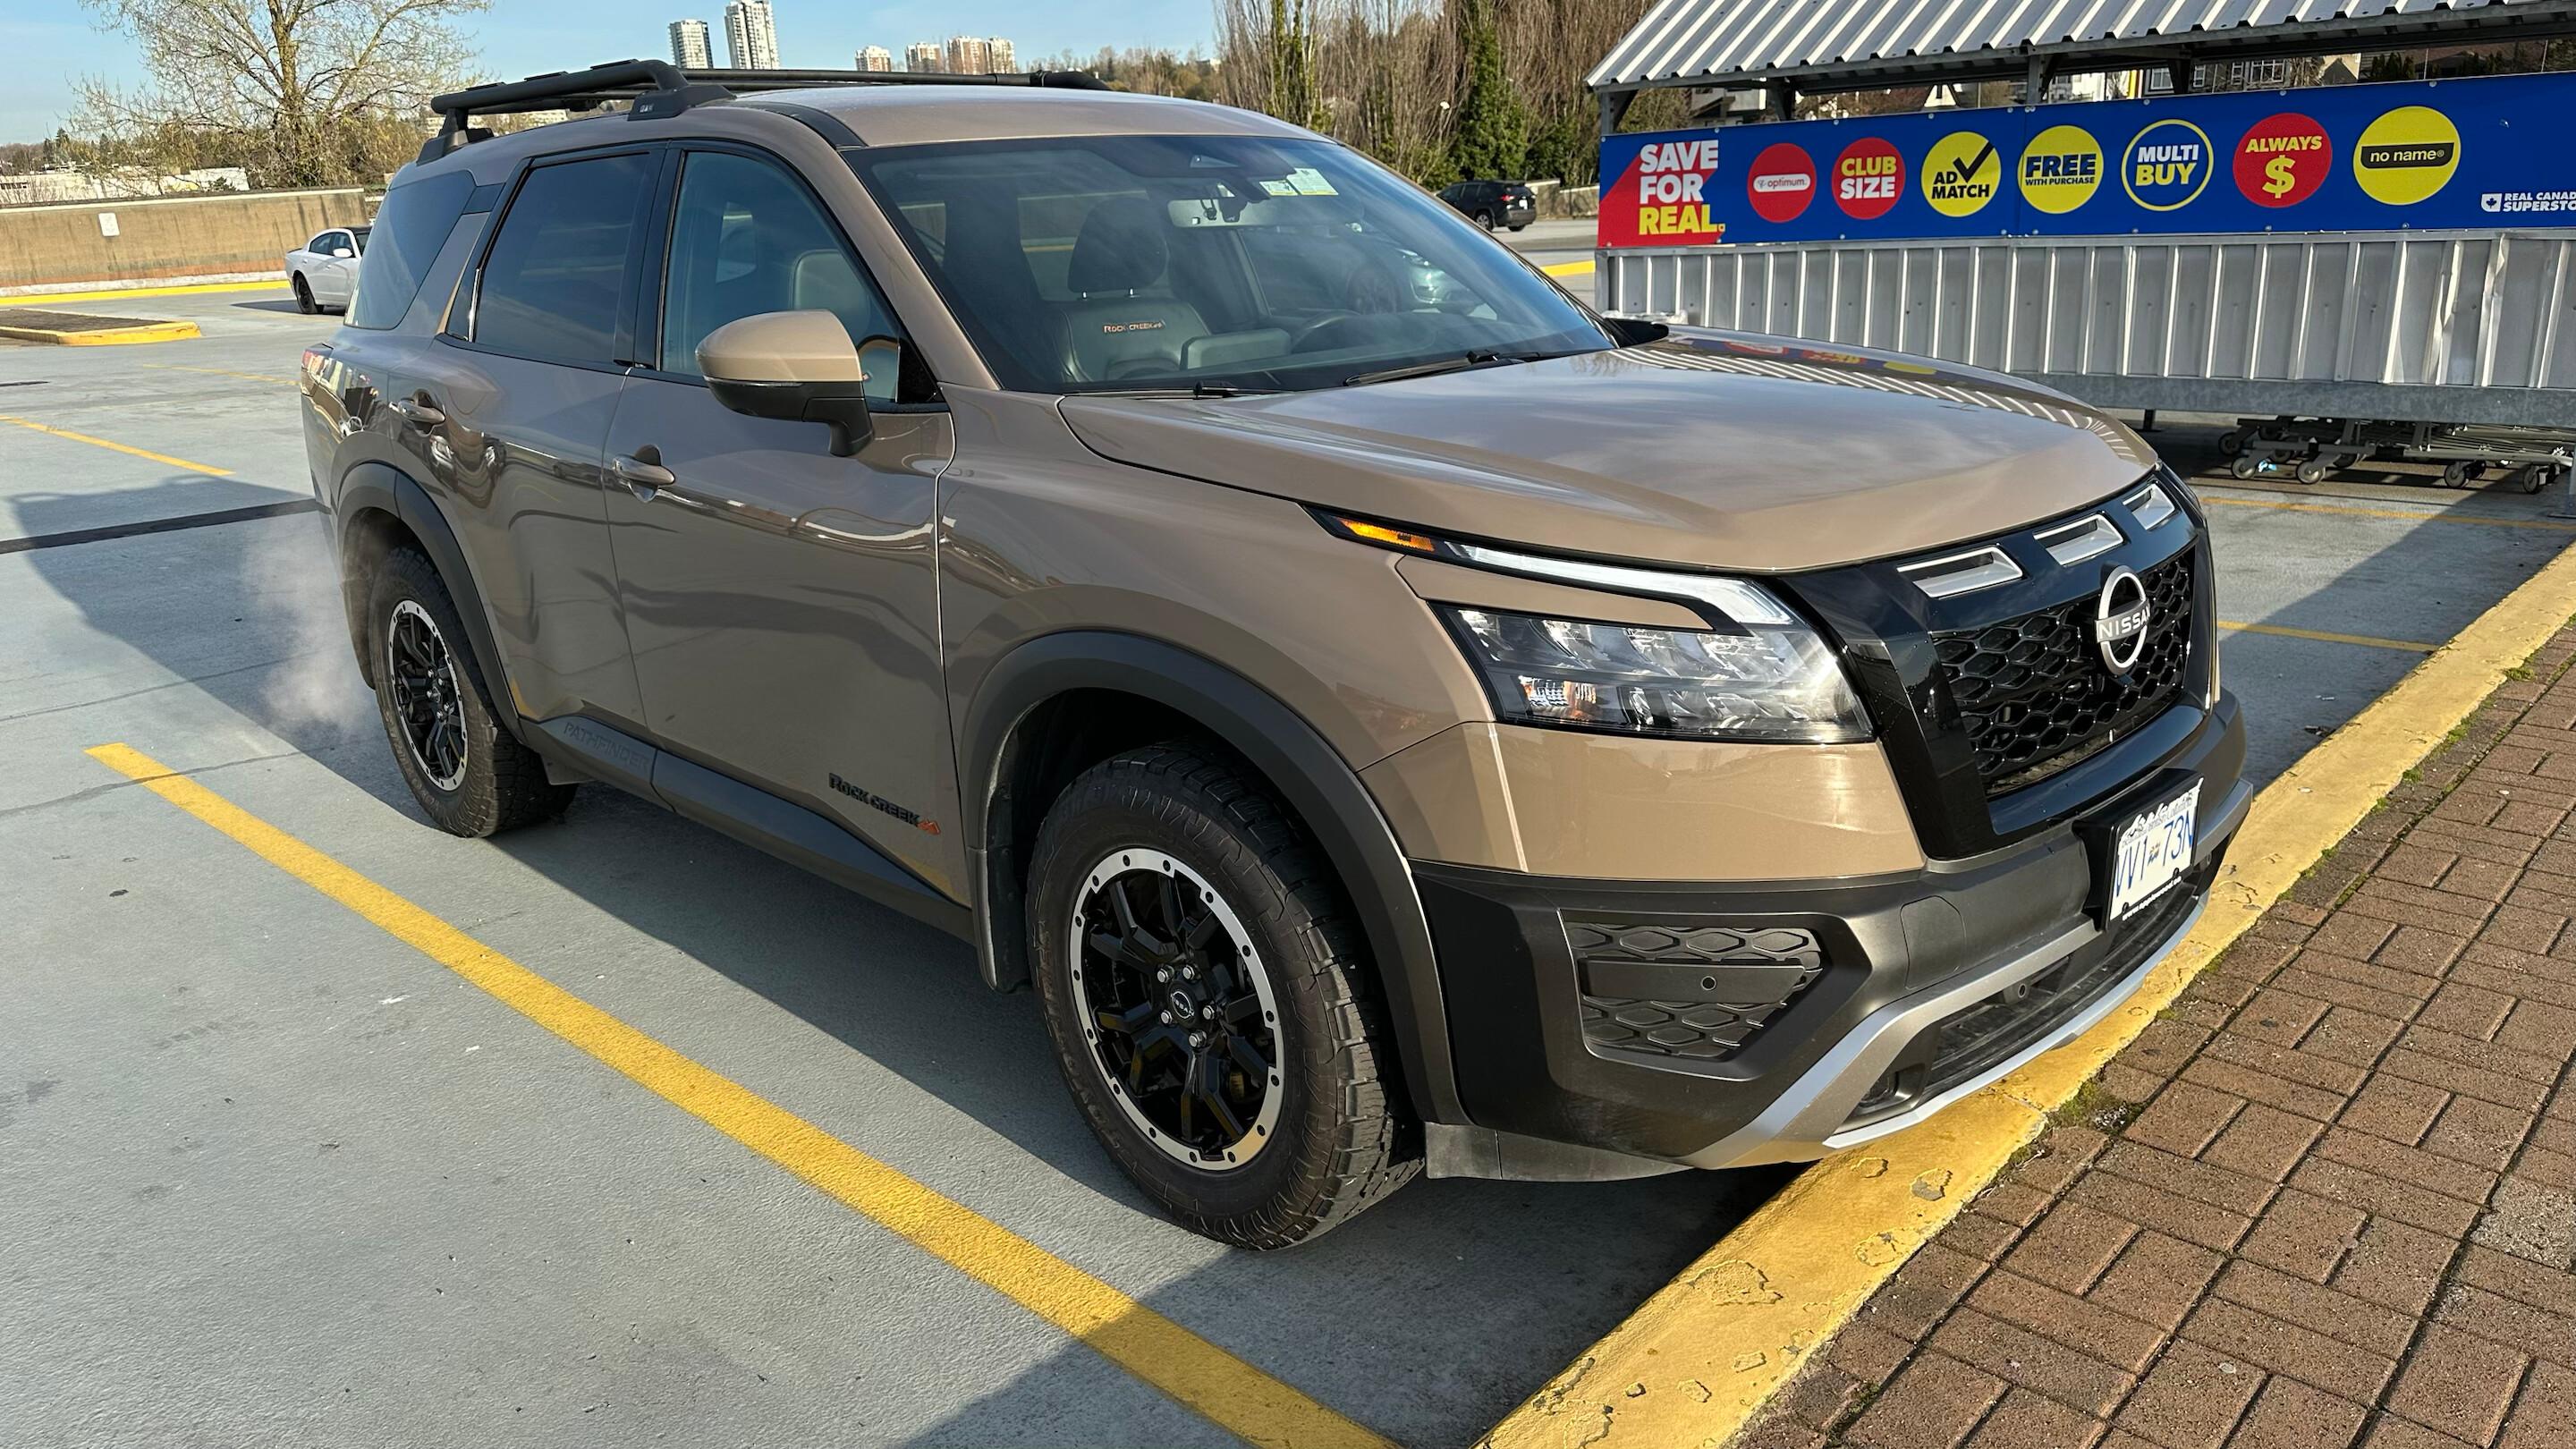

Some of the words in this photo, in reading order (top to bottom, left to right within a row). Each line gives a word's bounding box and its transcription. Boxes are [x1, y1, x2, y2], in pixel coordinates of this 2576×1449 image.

[2137, 144, 2199, 163] MULTI
[2245, 136, 2323, 153] ALWAYS
[1640, 140, 1719, 174] SAVE
[1841, 156, 1897, 176] CLUB
[2025, 153, 2097, 178] FREE
[2370, 150, 2390, 163] no
[1933, 171, 1958, 185] AD
[2048, 177, 2095, 185] PURCHASE
[2135, 163, 2197, 186] BUY
[2262, 155, 2296, 199] $
[1640, 173, 1704, 205] FOR
[1839, 176, 1895, 199] SIZE
[1931, 184, 1990, 199] MATCH
[2504, 192, 2533, 201] REAL
[2503, 199, 2576, 212] SUPERSTO
[1639, 204, 1726, 235] REAL.
[2098, 606, 2151, 640] NISSAN
[828, 772, 869, 805] ROCK
[869, 794, 920, 827] CREEK
